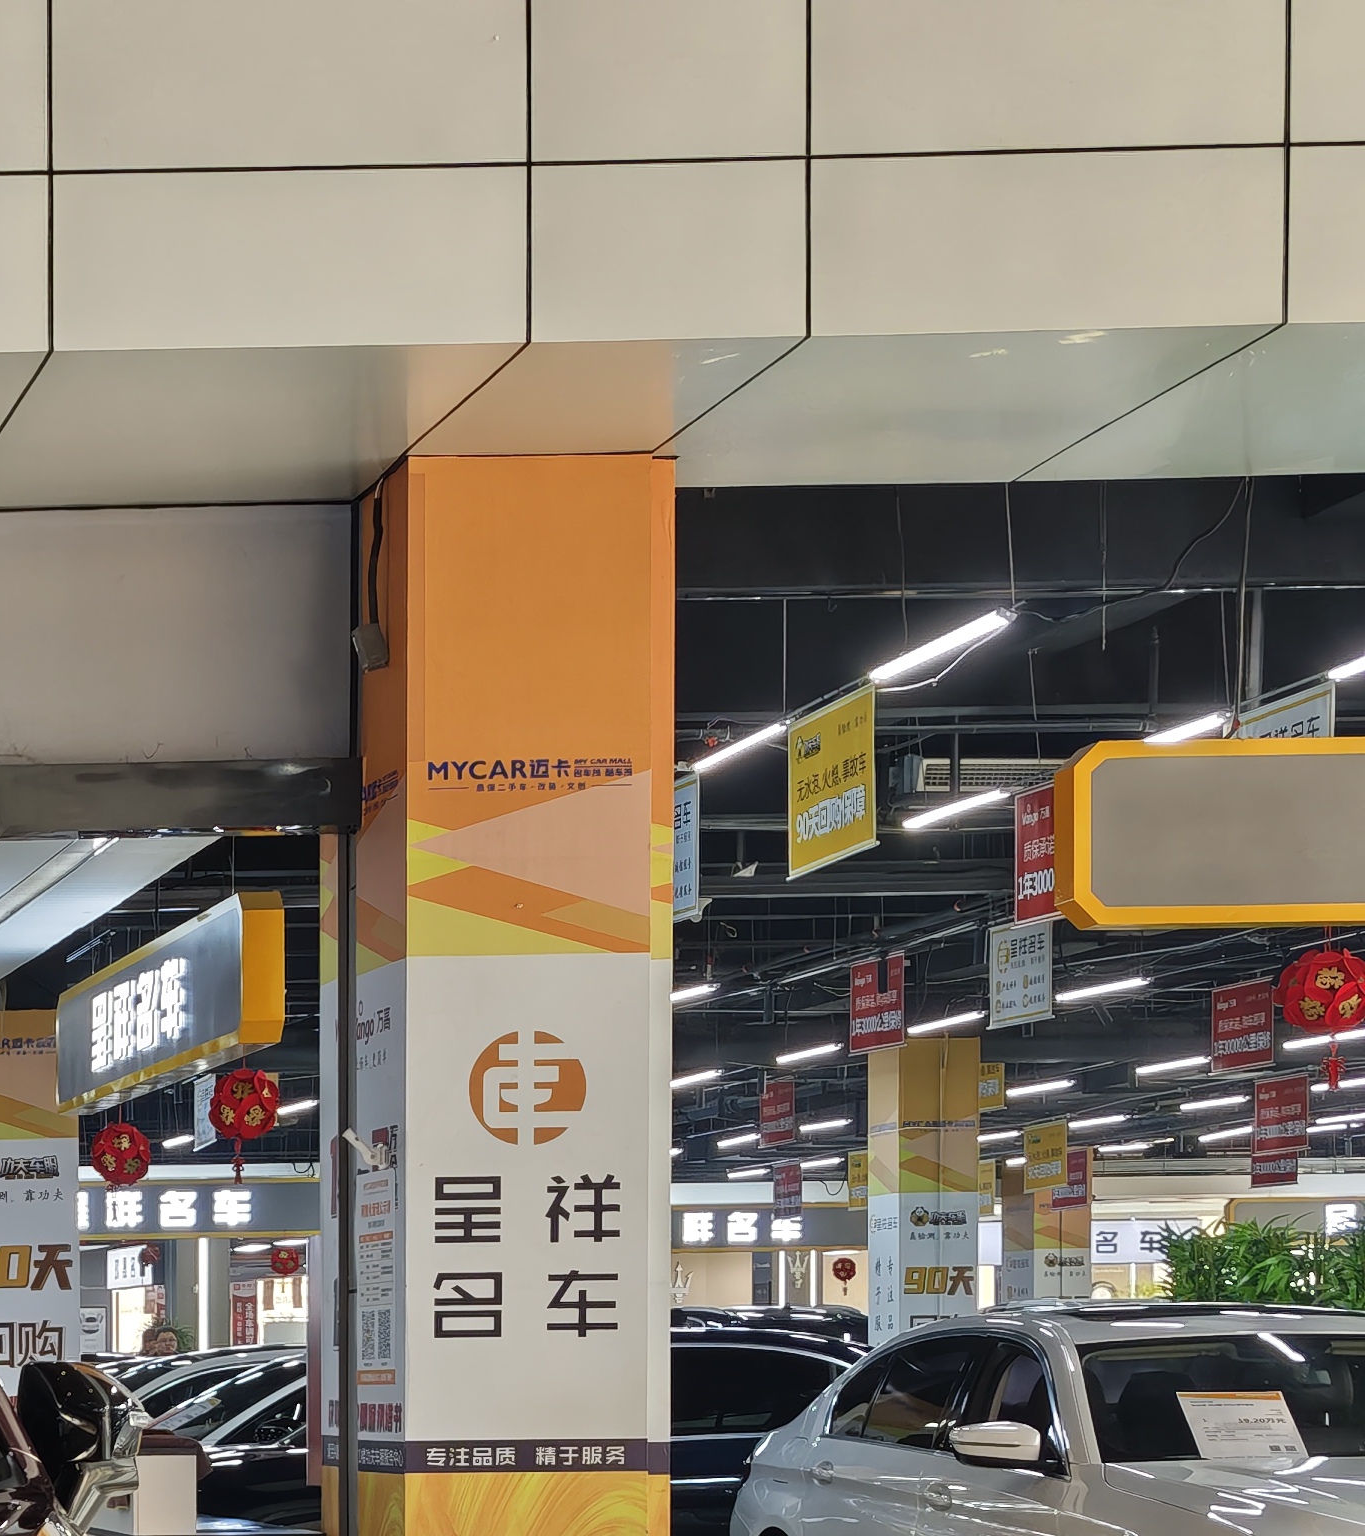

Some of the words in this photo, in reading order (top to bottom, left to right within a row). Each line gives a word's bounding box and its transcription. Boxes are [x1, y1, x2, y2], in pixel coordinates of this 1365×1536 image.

[796, 784, 866, 844] 90天回购保障
[434, 1175, 621, 1243] 呈祥
[433, 1269, 619, 1338] 名车
[904, 1265, 974, 1295] 90天
[425, 1445, 517, 1467] 专注品质
[534, 1445, 627, 1467] 精于服务
